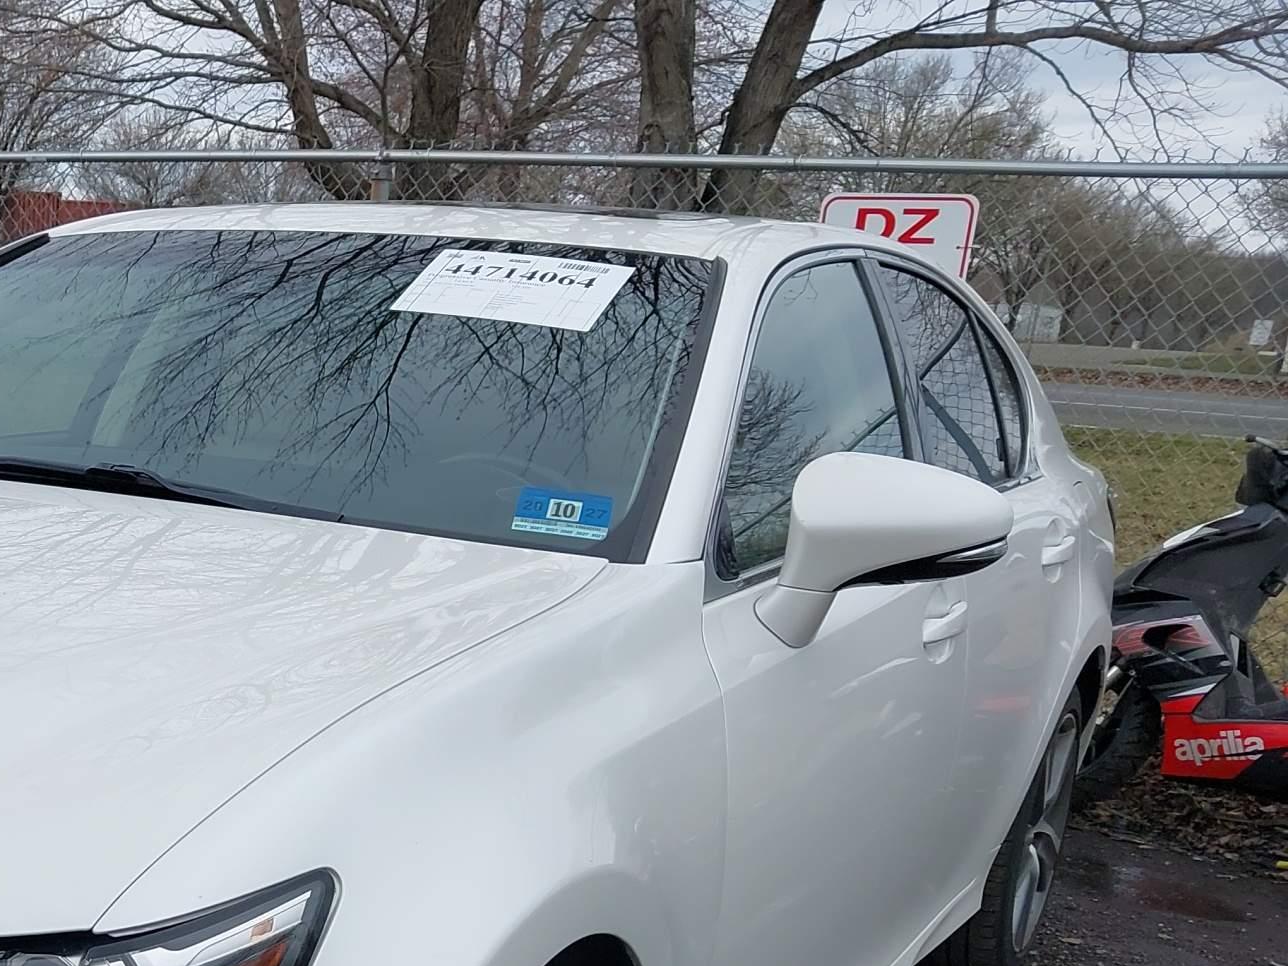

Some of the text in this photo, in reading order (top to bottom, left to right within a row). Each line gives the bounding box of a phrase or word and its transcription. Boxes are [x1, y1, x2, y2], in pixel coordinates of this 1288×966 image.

[855, 208, 940, 244] DZ
[445, 263, 597, 289] 44714064
[550, 501, 576, 519] 10
[1174, 730, 1265, 767] aprilia
